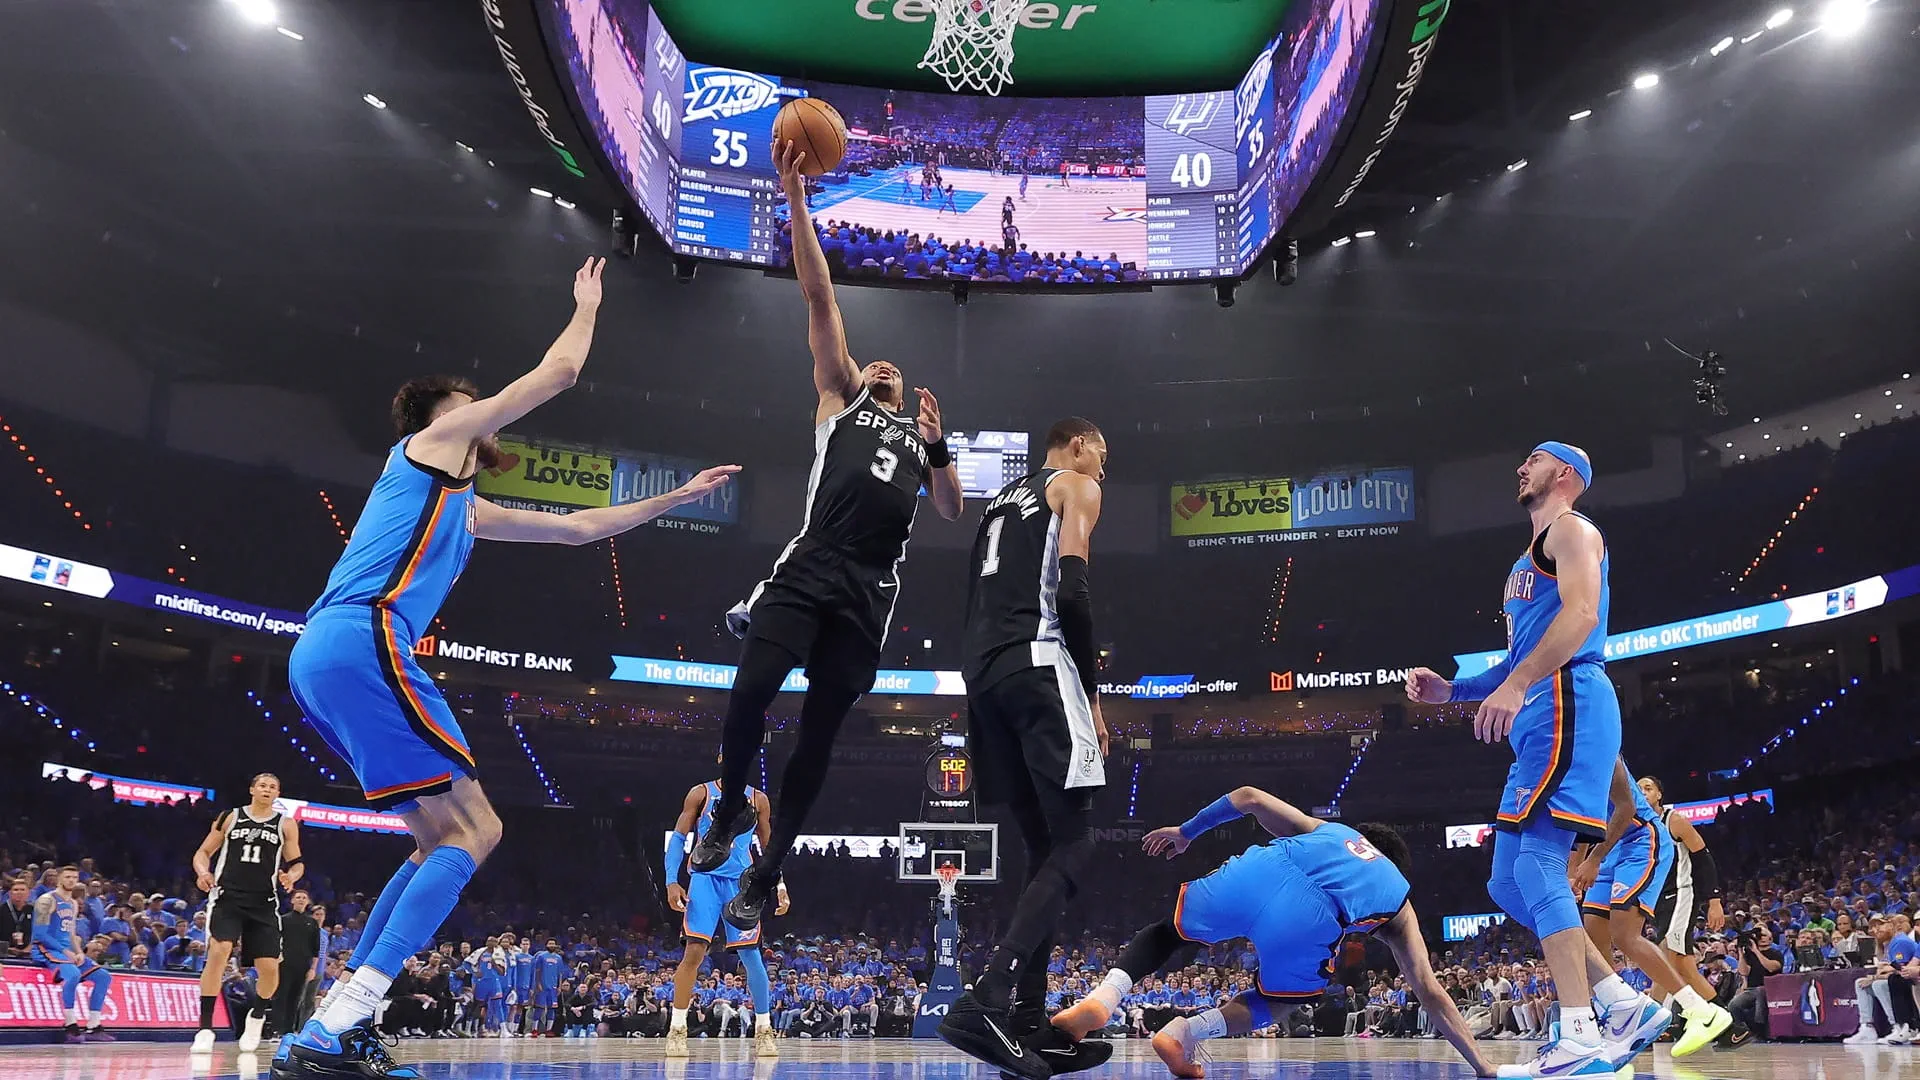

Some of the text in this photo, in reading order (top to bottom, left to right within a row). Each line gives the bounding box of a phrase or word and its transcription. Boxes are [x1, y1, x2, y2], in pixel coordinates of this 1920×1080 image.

[855, 0, 1097, 30] ceer
[1375, 34, 1435, 144] paycom
[651, 90, 672, 140] 40
[710, 129, 748, 168] 35
[1248, 119, 1263, 168] 35
[681, 168, 773, 188] PLAYER PTS FL
[1171, 153, 1212, 188] 40
[1148, 197, 1171, 205] PLAYER
[870, 447, 898, 482] 3
[1297, 479, 1409, 522] LOUD CITY
[656, 518, 720, 534] EXIT NOW
[981, 516, 1005, 576] 1
[1188, 526, 1399, 548] BRING THE THUNDER EXIT NOW
[155, 593, 307, 635] midfirst.com/spec
[1616, 639, 1631, 655] of
[1633, 633, 1657, 651] the
[1660, 625, 1691, 646] OKC
[1693, 613, 1760, 640] Thunder
[523, 653, 572, 672] BANK
[645, 663, 672, 680] The
[675, 665, 729, 684] Official
[790, 671, 810, 688] th
[874, 674, 911, 689] nder
[1376, 668, 1416, 685] BAN
[1097, 681, 1238, 697] rst.com/special-offer
[941, 760, 966, 771] 6:02
[944, 771, 963, 792] 17
[301, 809, 326, 820] BUILT
[327, 812, 348, 822] FOR
[240, 844, 261, 863] 11
[121, 981, 151, 1022] FLY
[152, 982, 200, 1022] BETTE
